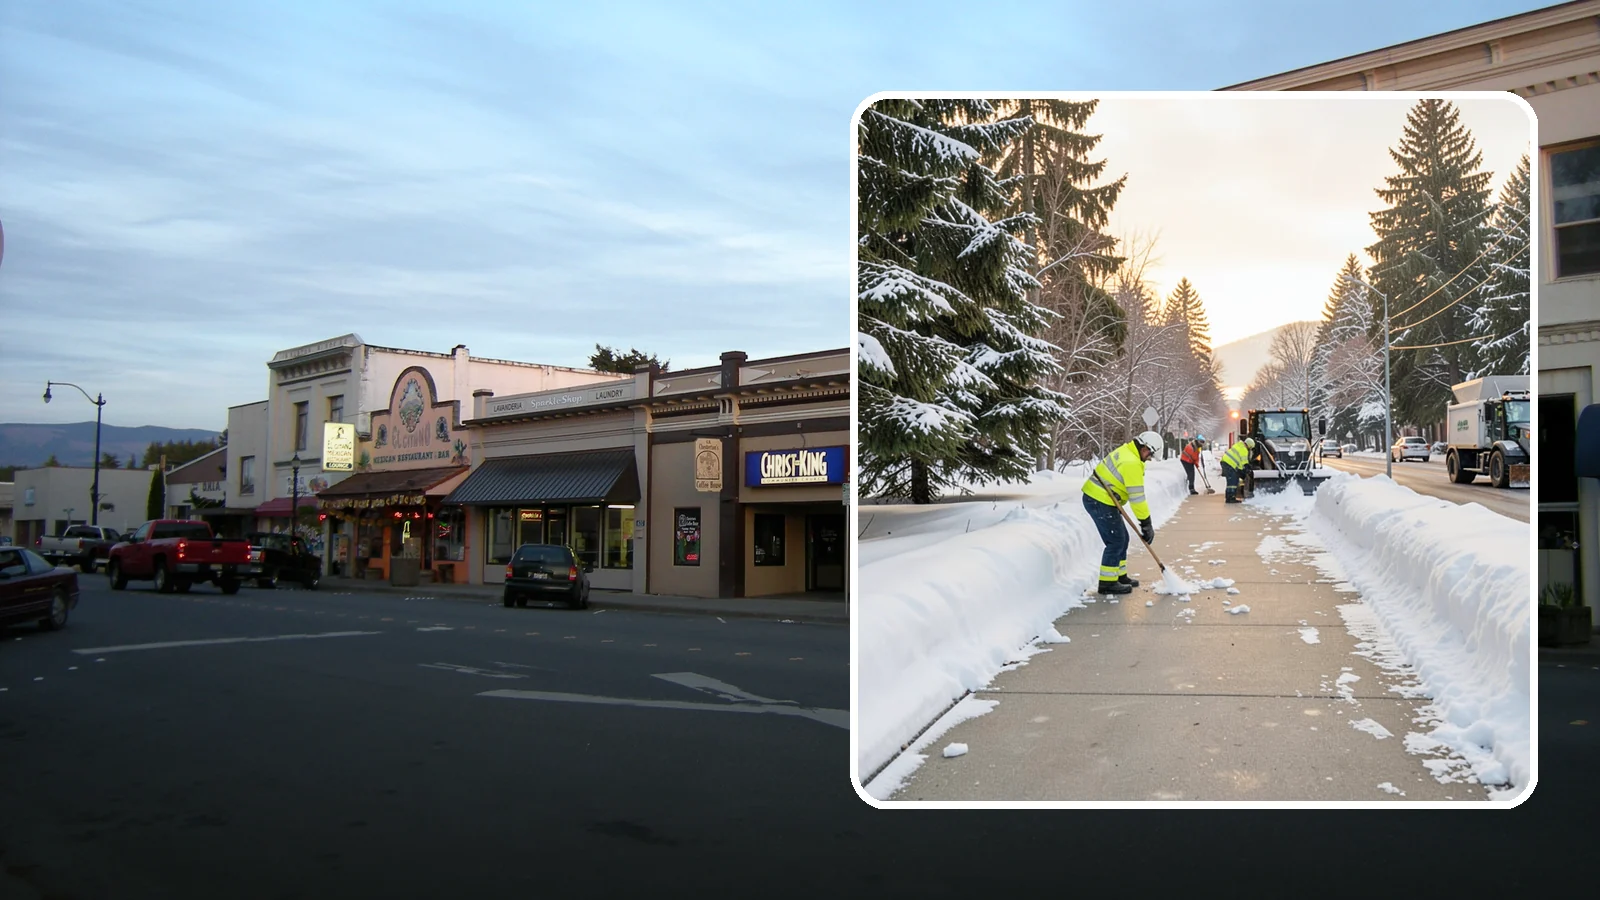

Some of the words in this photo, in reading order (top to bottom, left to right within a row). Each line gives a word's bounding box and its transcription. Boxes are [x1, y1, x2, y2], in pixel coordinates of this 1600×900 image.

[531, 396, 561, 408] Sparkle
[560, 393, 582, 404] Shop
[596, 389, 623, 399] LAUNDRY
[494, 402, 522, 413] LAVANDERIA
[391, 425, 402, 449] EL
[373, 455, 396, 464] MEXICAN
[397, 451, 433, 462] RESTAURANT
[438, 450, 450, 459] BAR
[761, 452, 797, 477] CHRIST
[800, 450, 827, 476] KING
